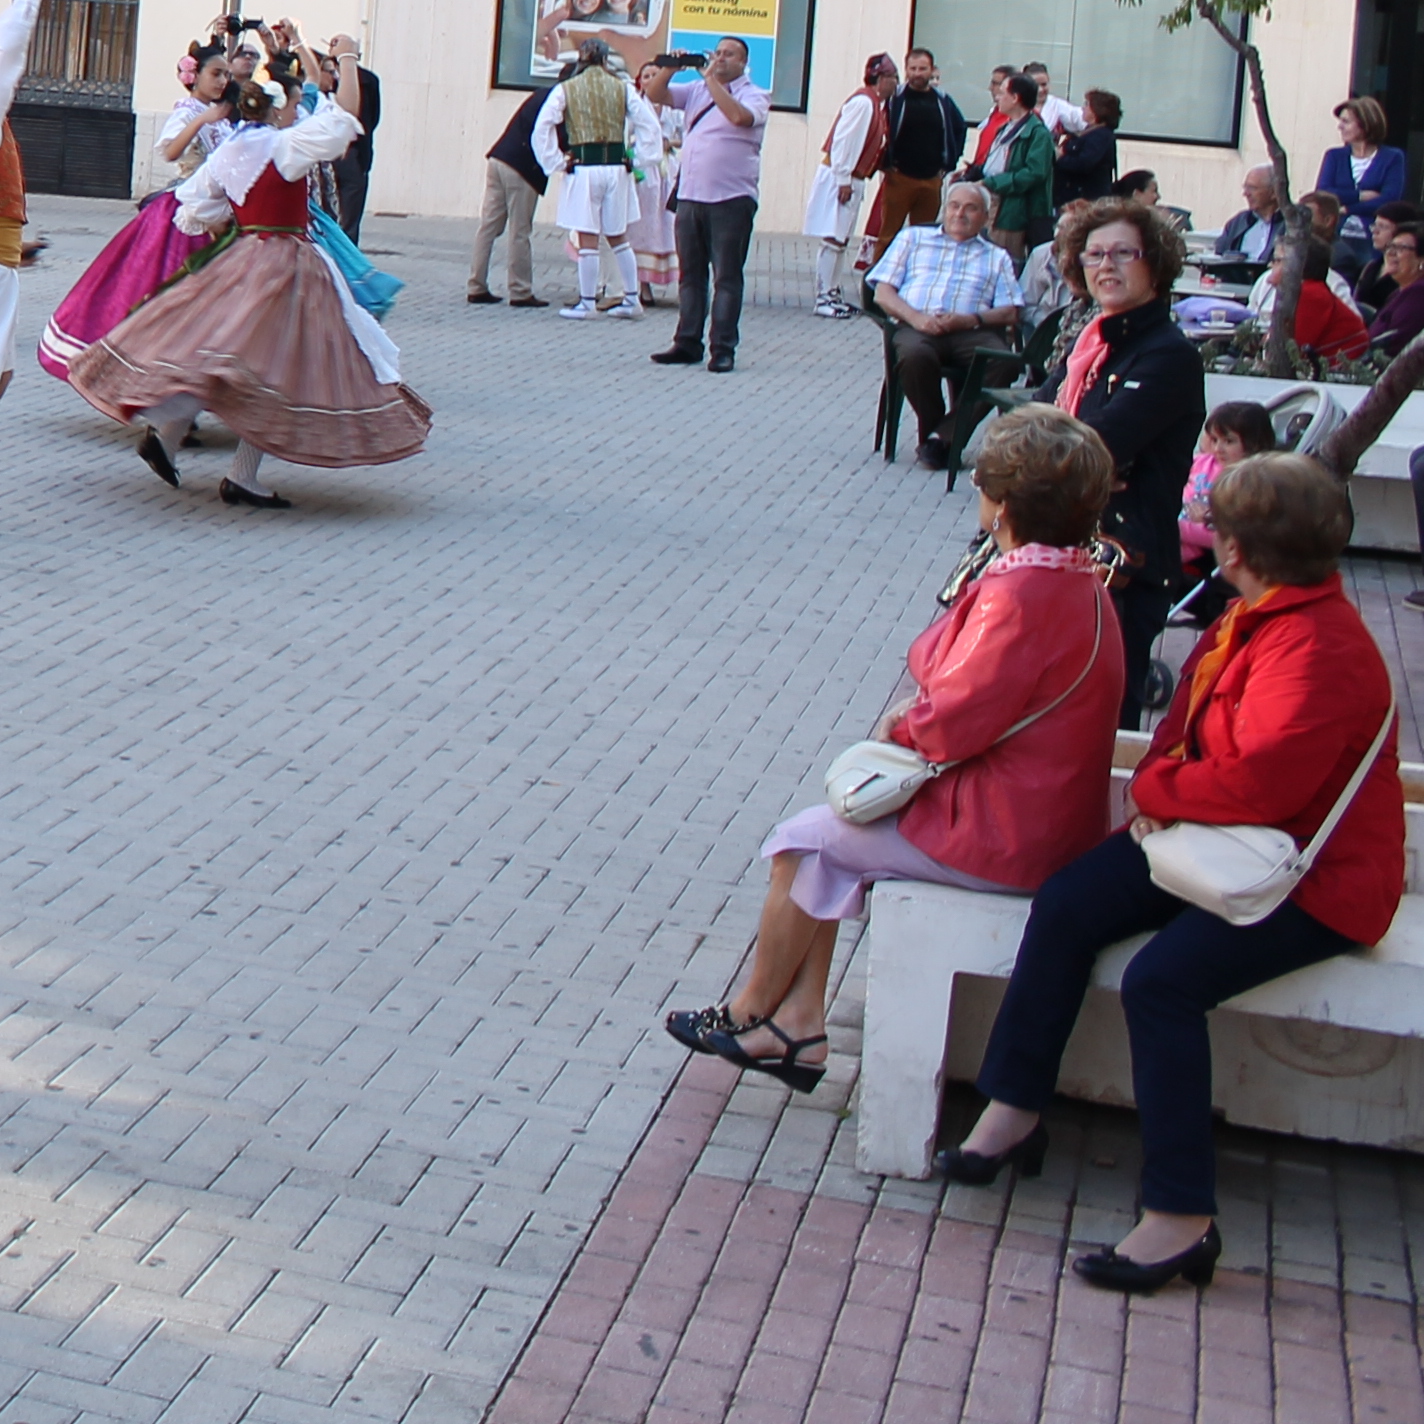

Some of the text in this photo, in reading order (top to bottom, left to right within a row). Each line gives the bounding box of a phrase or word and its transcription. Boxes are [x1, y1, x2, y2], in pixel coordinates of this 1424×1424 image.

[683, 5, 769, 19] con tu nómina
